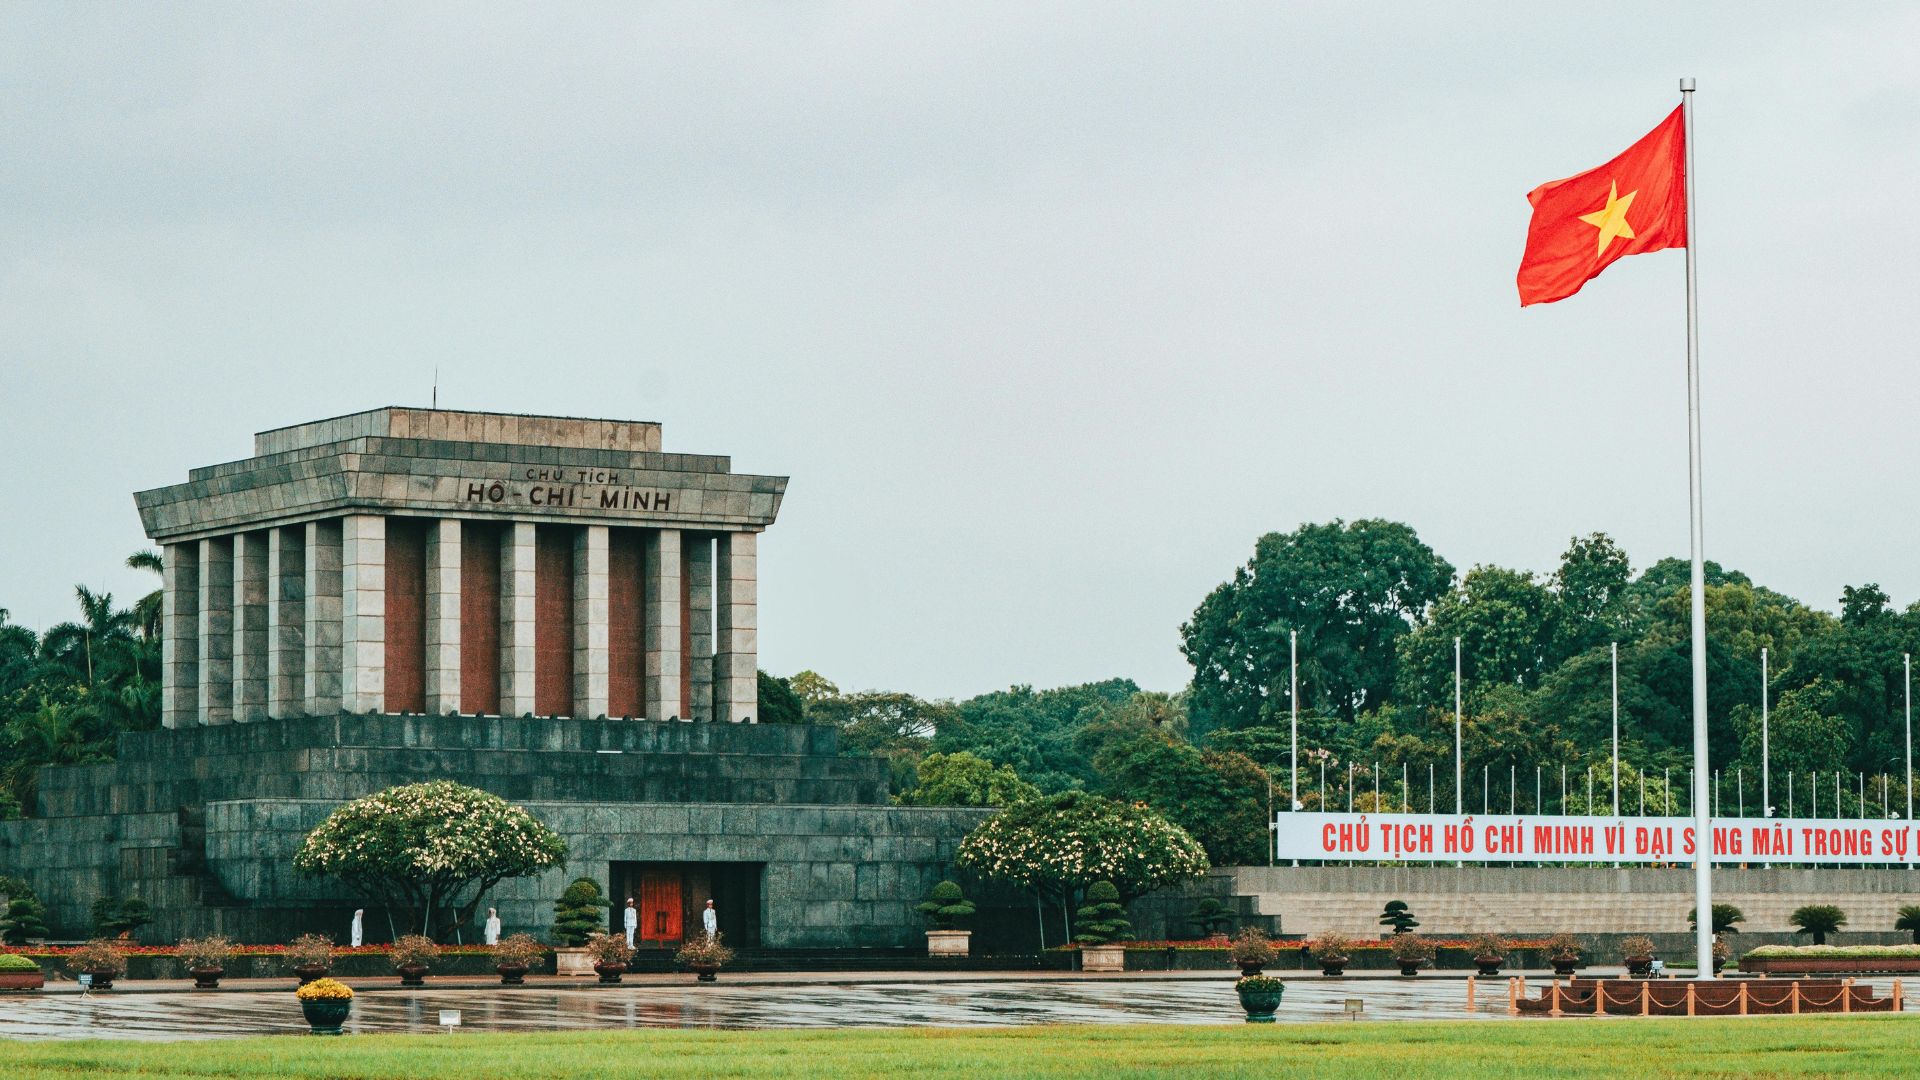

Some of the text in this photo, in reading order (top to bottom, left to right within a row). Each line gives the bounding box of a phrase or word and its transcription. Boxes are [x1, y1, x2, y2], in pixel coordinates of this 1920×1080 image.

[1322, 815, 1370, 852] CHỦ
[1380, 823, 1434, 859] TỊCH
[1444, 816, 1474, 854] HỒ
[1485, 819, 1524, 854] CHÍ
[1534, 825, 1594, 855] MINH
[1635, 826, 1673, 860] ĐẠI
[1683, 819, 1743, 856] SNG
[1752, 822, 1793, 856] MÃI
[1802, 828, 1873, 856] TRONG
[1881, 826, 1910, 862] SỰ
